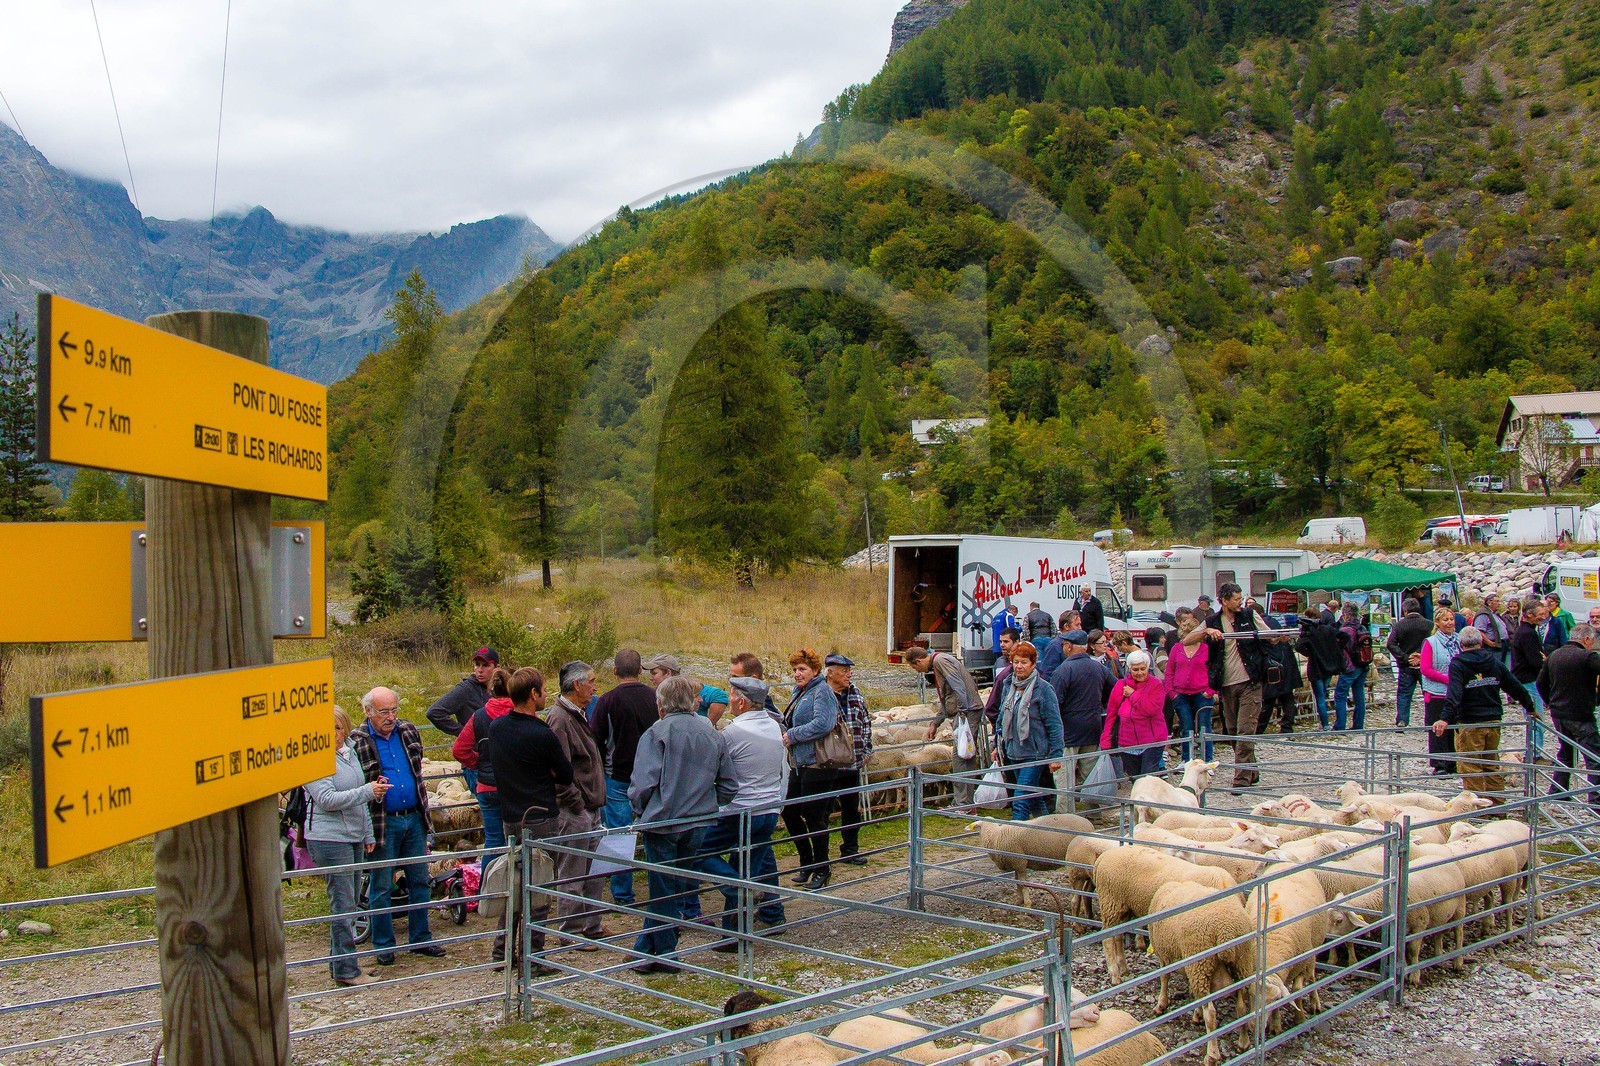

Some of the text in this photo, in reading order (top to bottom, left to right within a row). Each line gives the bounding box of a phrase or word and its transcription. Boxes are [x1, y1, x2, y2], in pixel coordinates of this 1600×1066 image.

[84, 339, 132, 376] 9.9 km
[83, 402, 131, 434] 7.7 km
[233, 383, 322, 427] PONT DU FOSSÉ
[204, 432, 322, 472] 2h30 LES RICHARDS
[974, 566, 1023, 609] Ailloud
[1037, 550, 1087, 590] Perraud
[273, 691, 288, 714] LA
[290, 683, 329, 710] COCHE
[79, 724, 130, 753] 7.1 km
[246, 744, 282, 771] Roche
[286, 737, 299, 760] de
[302, 732, 331, 755] Bidou
[82, 785, 131, 816] 1.1 km
